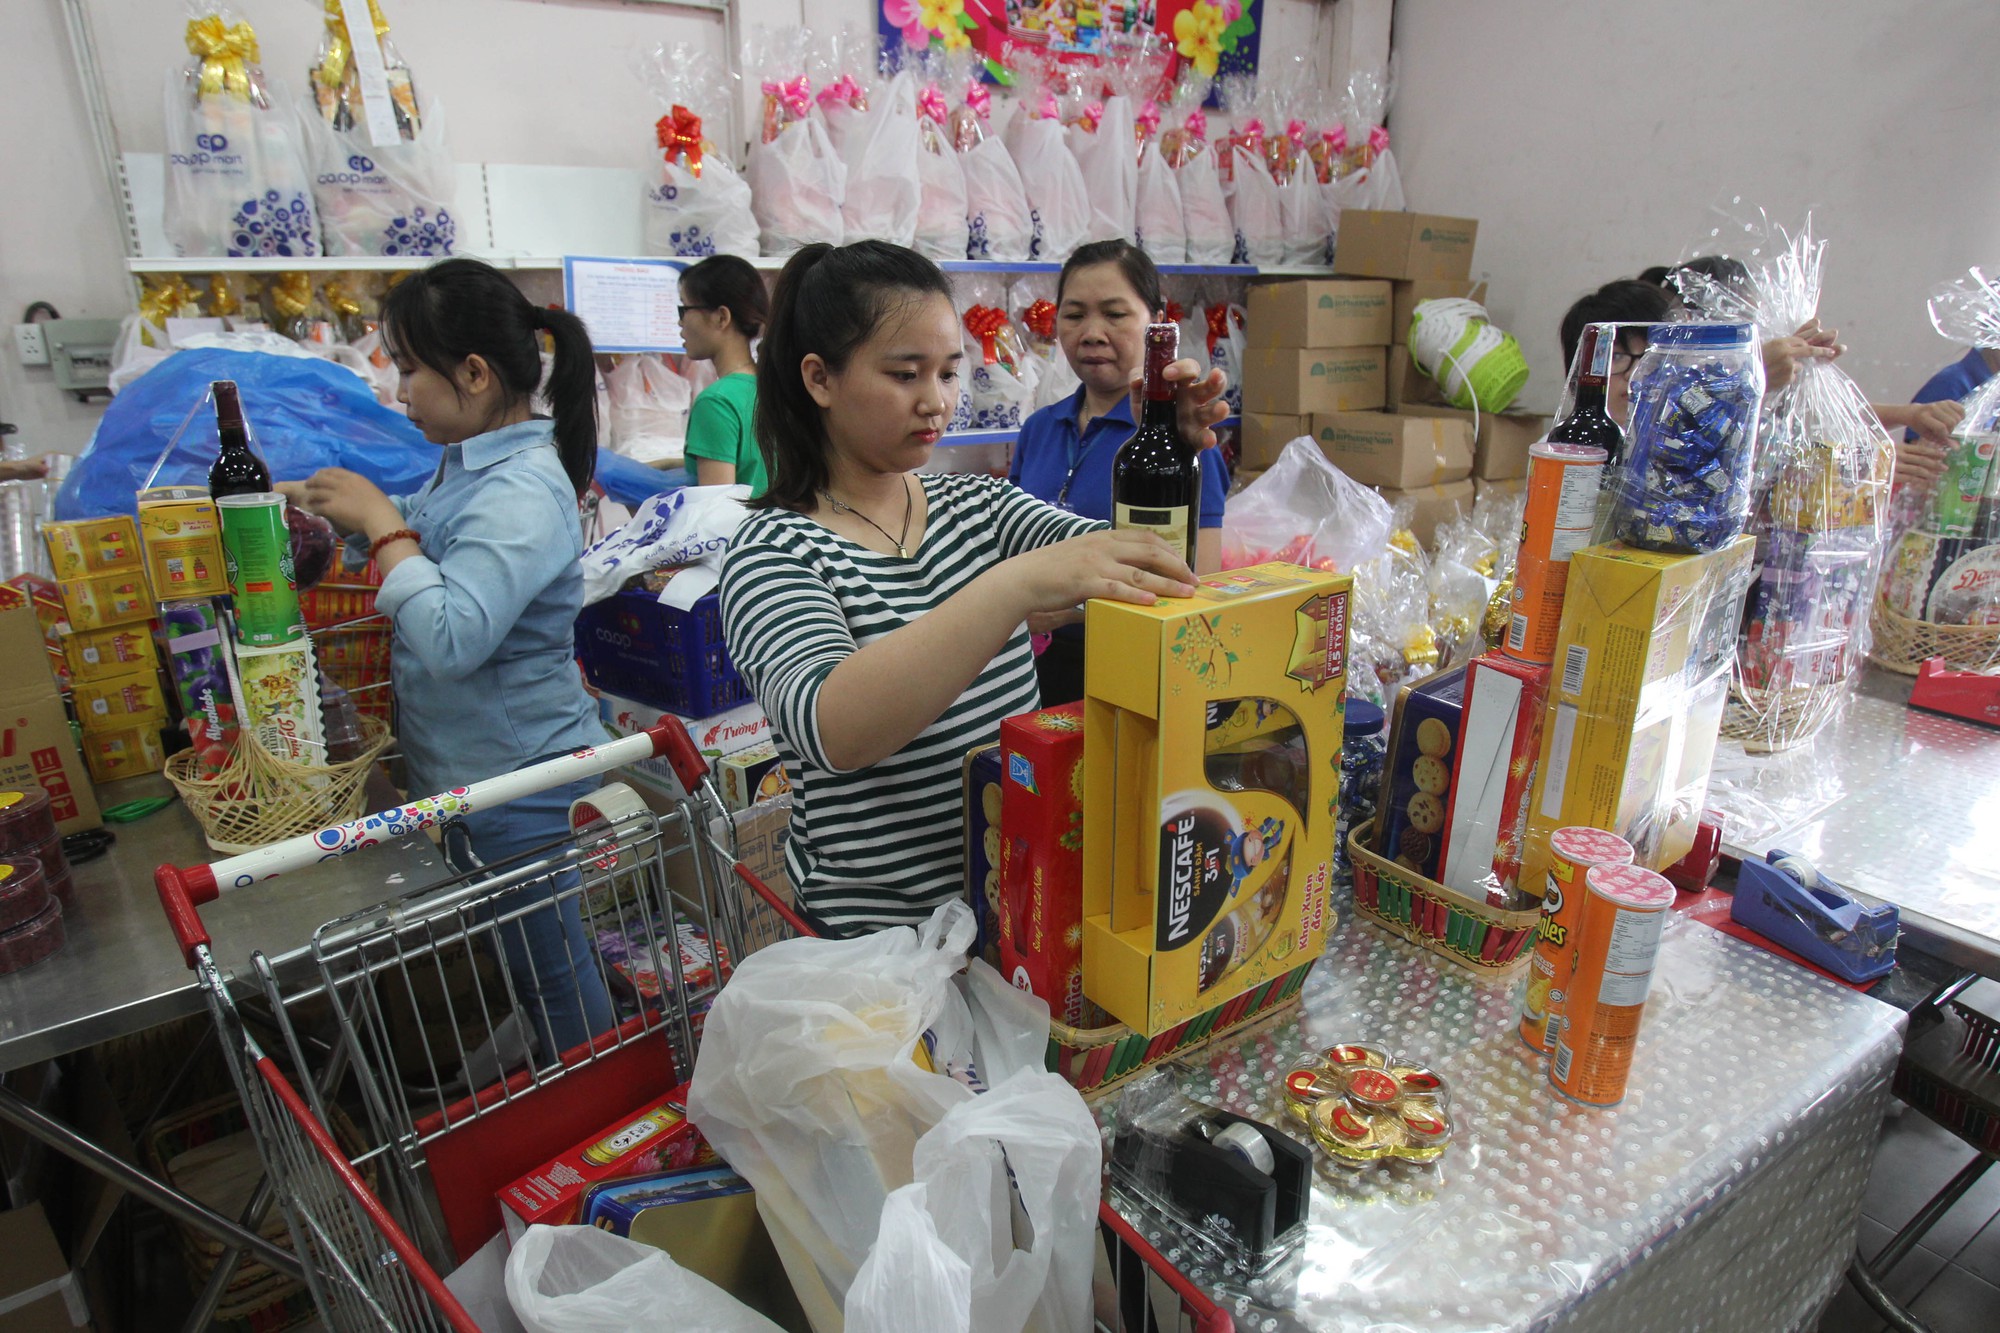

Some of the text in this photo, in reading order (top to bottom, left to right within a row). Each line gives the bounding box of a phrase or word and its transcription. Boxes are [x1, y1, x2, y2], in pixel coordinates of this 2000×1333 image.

[199, 688, 224, 741] Alpenliebe
[722, 722, 758, 741] Tường
[1167, 815, 1195, 941] NESCAFÉ
[1204, 847, 1220, 883] 3in1
[1299, 873, 1314, 951] Khai Xuân
[1311, 862, 1327, 931] đón Lộc
